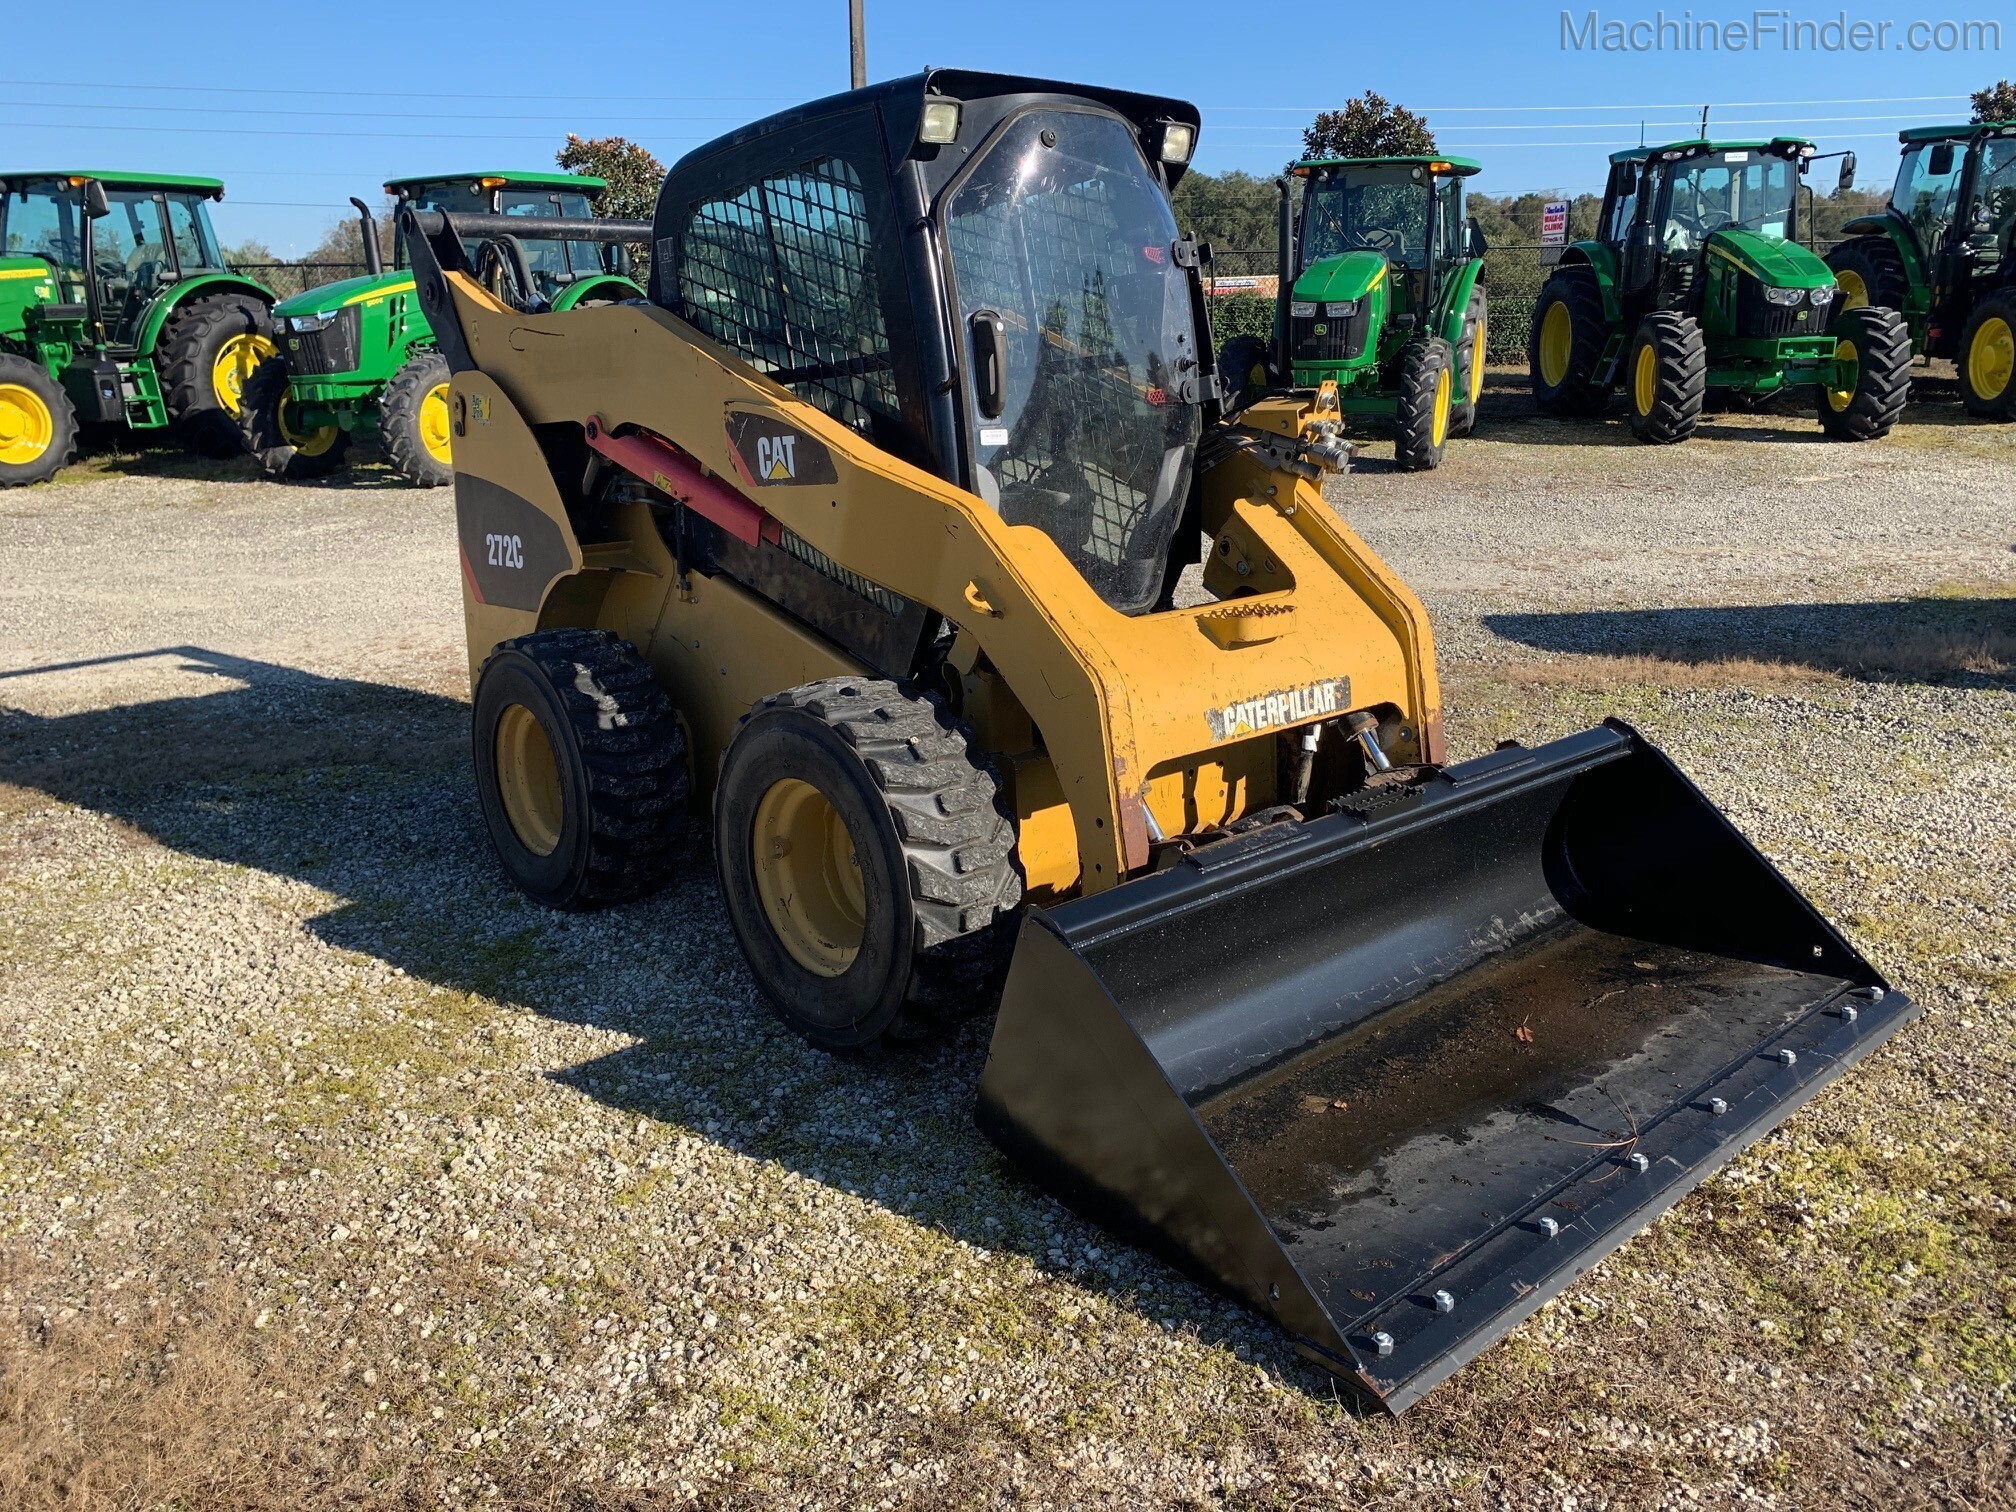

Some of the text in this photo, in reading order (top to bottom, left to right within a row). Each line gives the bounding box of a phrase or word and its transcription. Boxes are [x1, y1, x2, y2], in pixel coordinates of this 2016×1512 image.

[1543, 222, 1564, 231] CLINIC
[757, 435, 796, 480] CAT
[486, 533, 524, 570] 272C
[1222, 681, 1337, 737] CATERPILLAR
